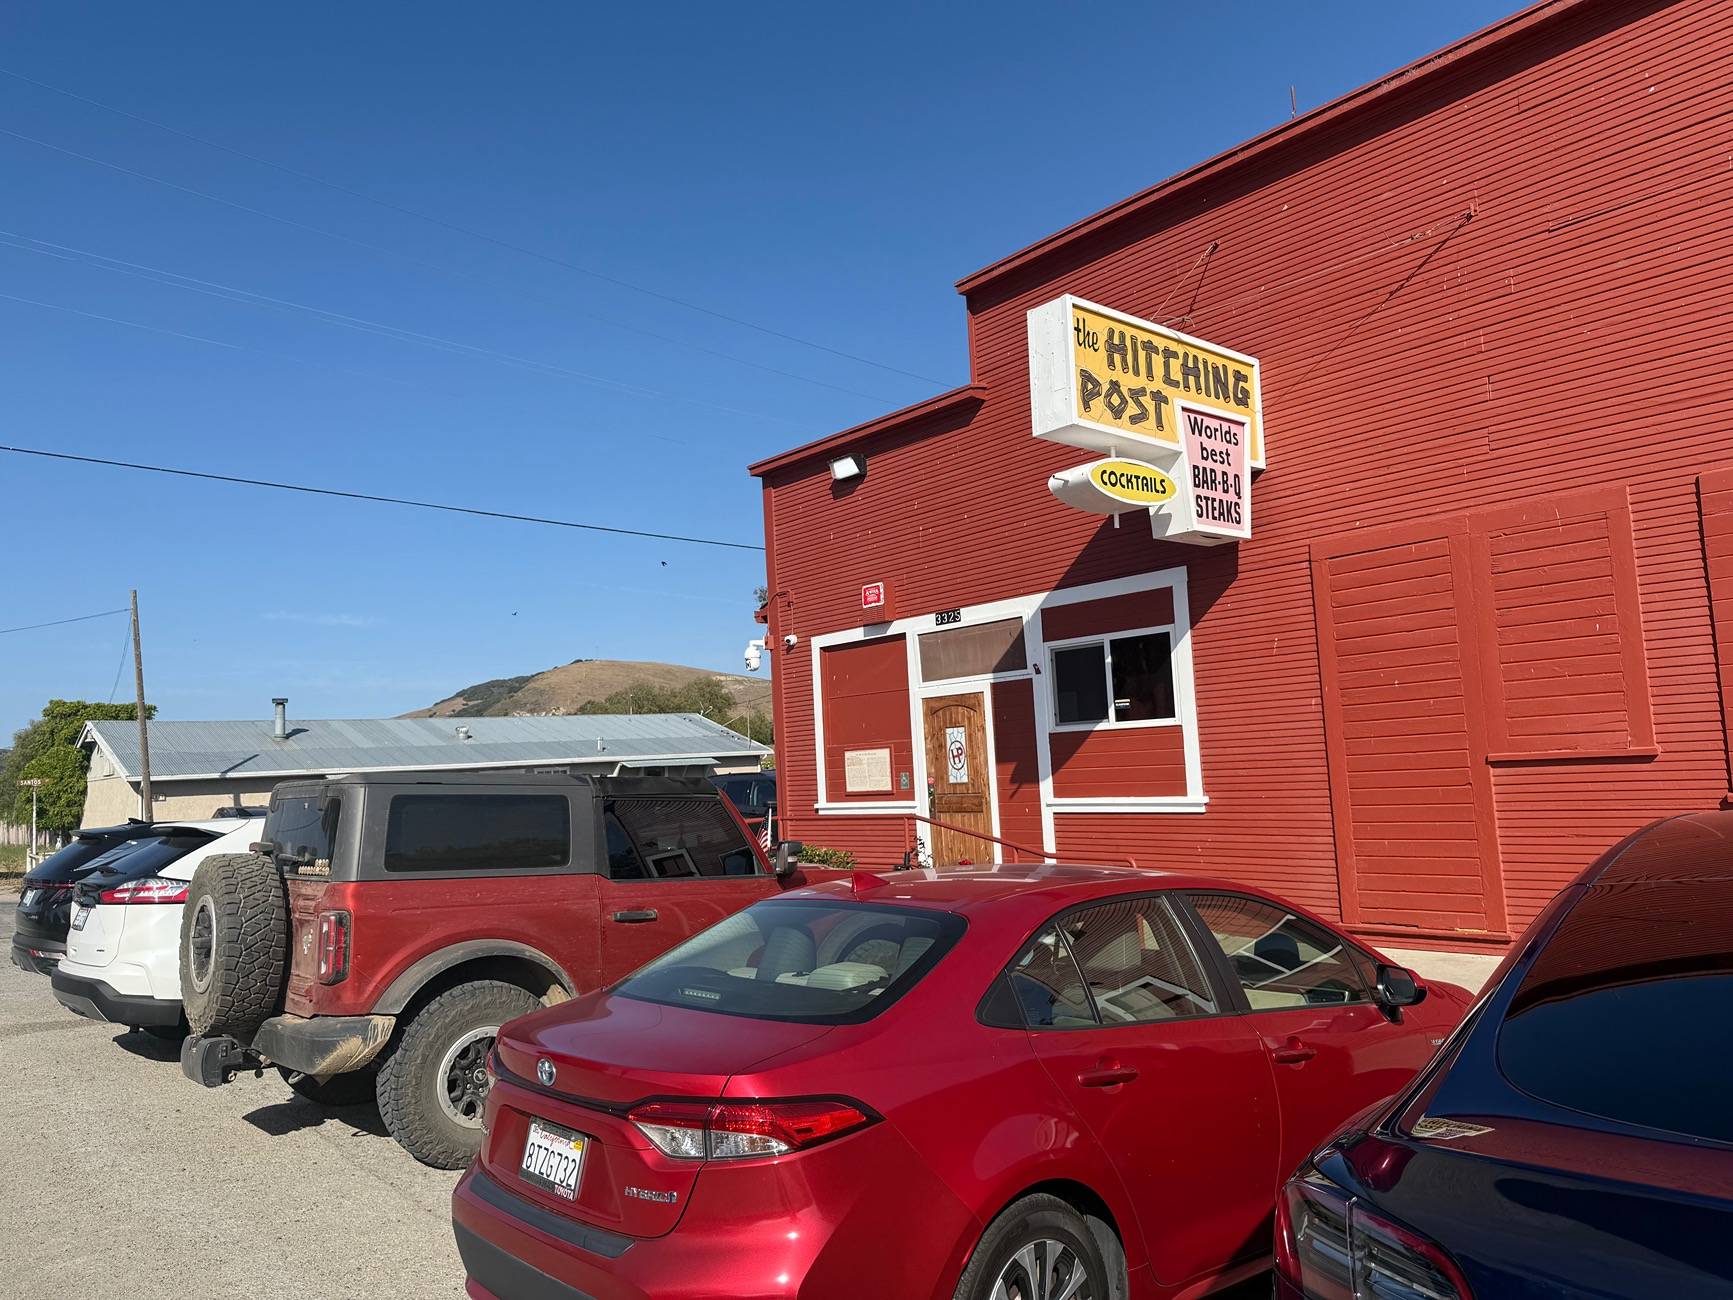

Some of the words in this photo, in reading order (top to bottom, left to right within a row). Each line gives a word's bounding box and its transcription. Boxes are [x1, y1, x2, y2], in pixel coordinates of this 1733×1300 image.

[1074, 317, 1100, 352] the
[1104, 327, 1250, 408] HITCHING
[1079, 368, 1169, 431] POST
[1187, 414, 1240, 446] Worlds
[1200, 442, 1231, 467] best
[1100, 469, 1167, 495] COCKTAILS
[1195, 495, 1242, 525] STEAKS
[935, 611, 961, 625] 3325
[525, 1142, 577, 1187] 8TZG732
[554, 1184, 574, 1200] TOYOTA
